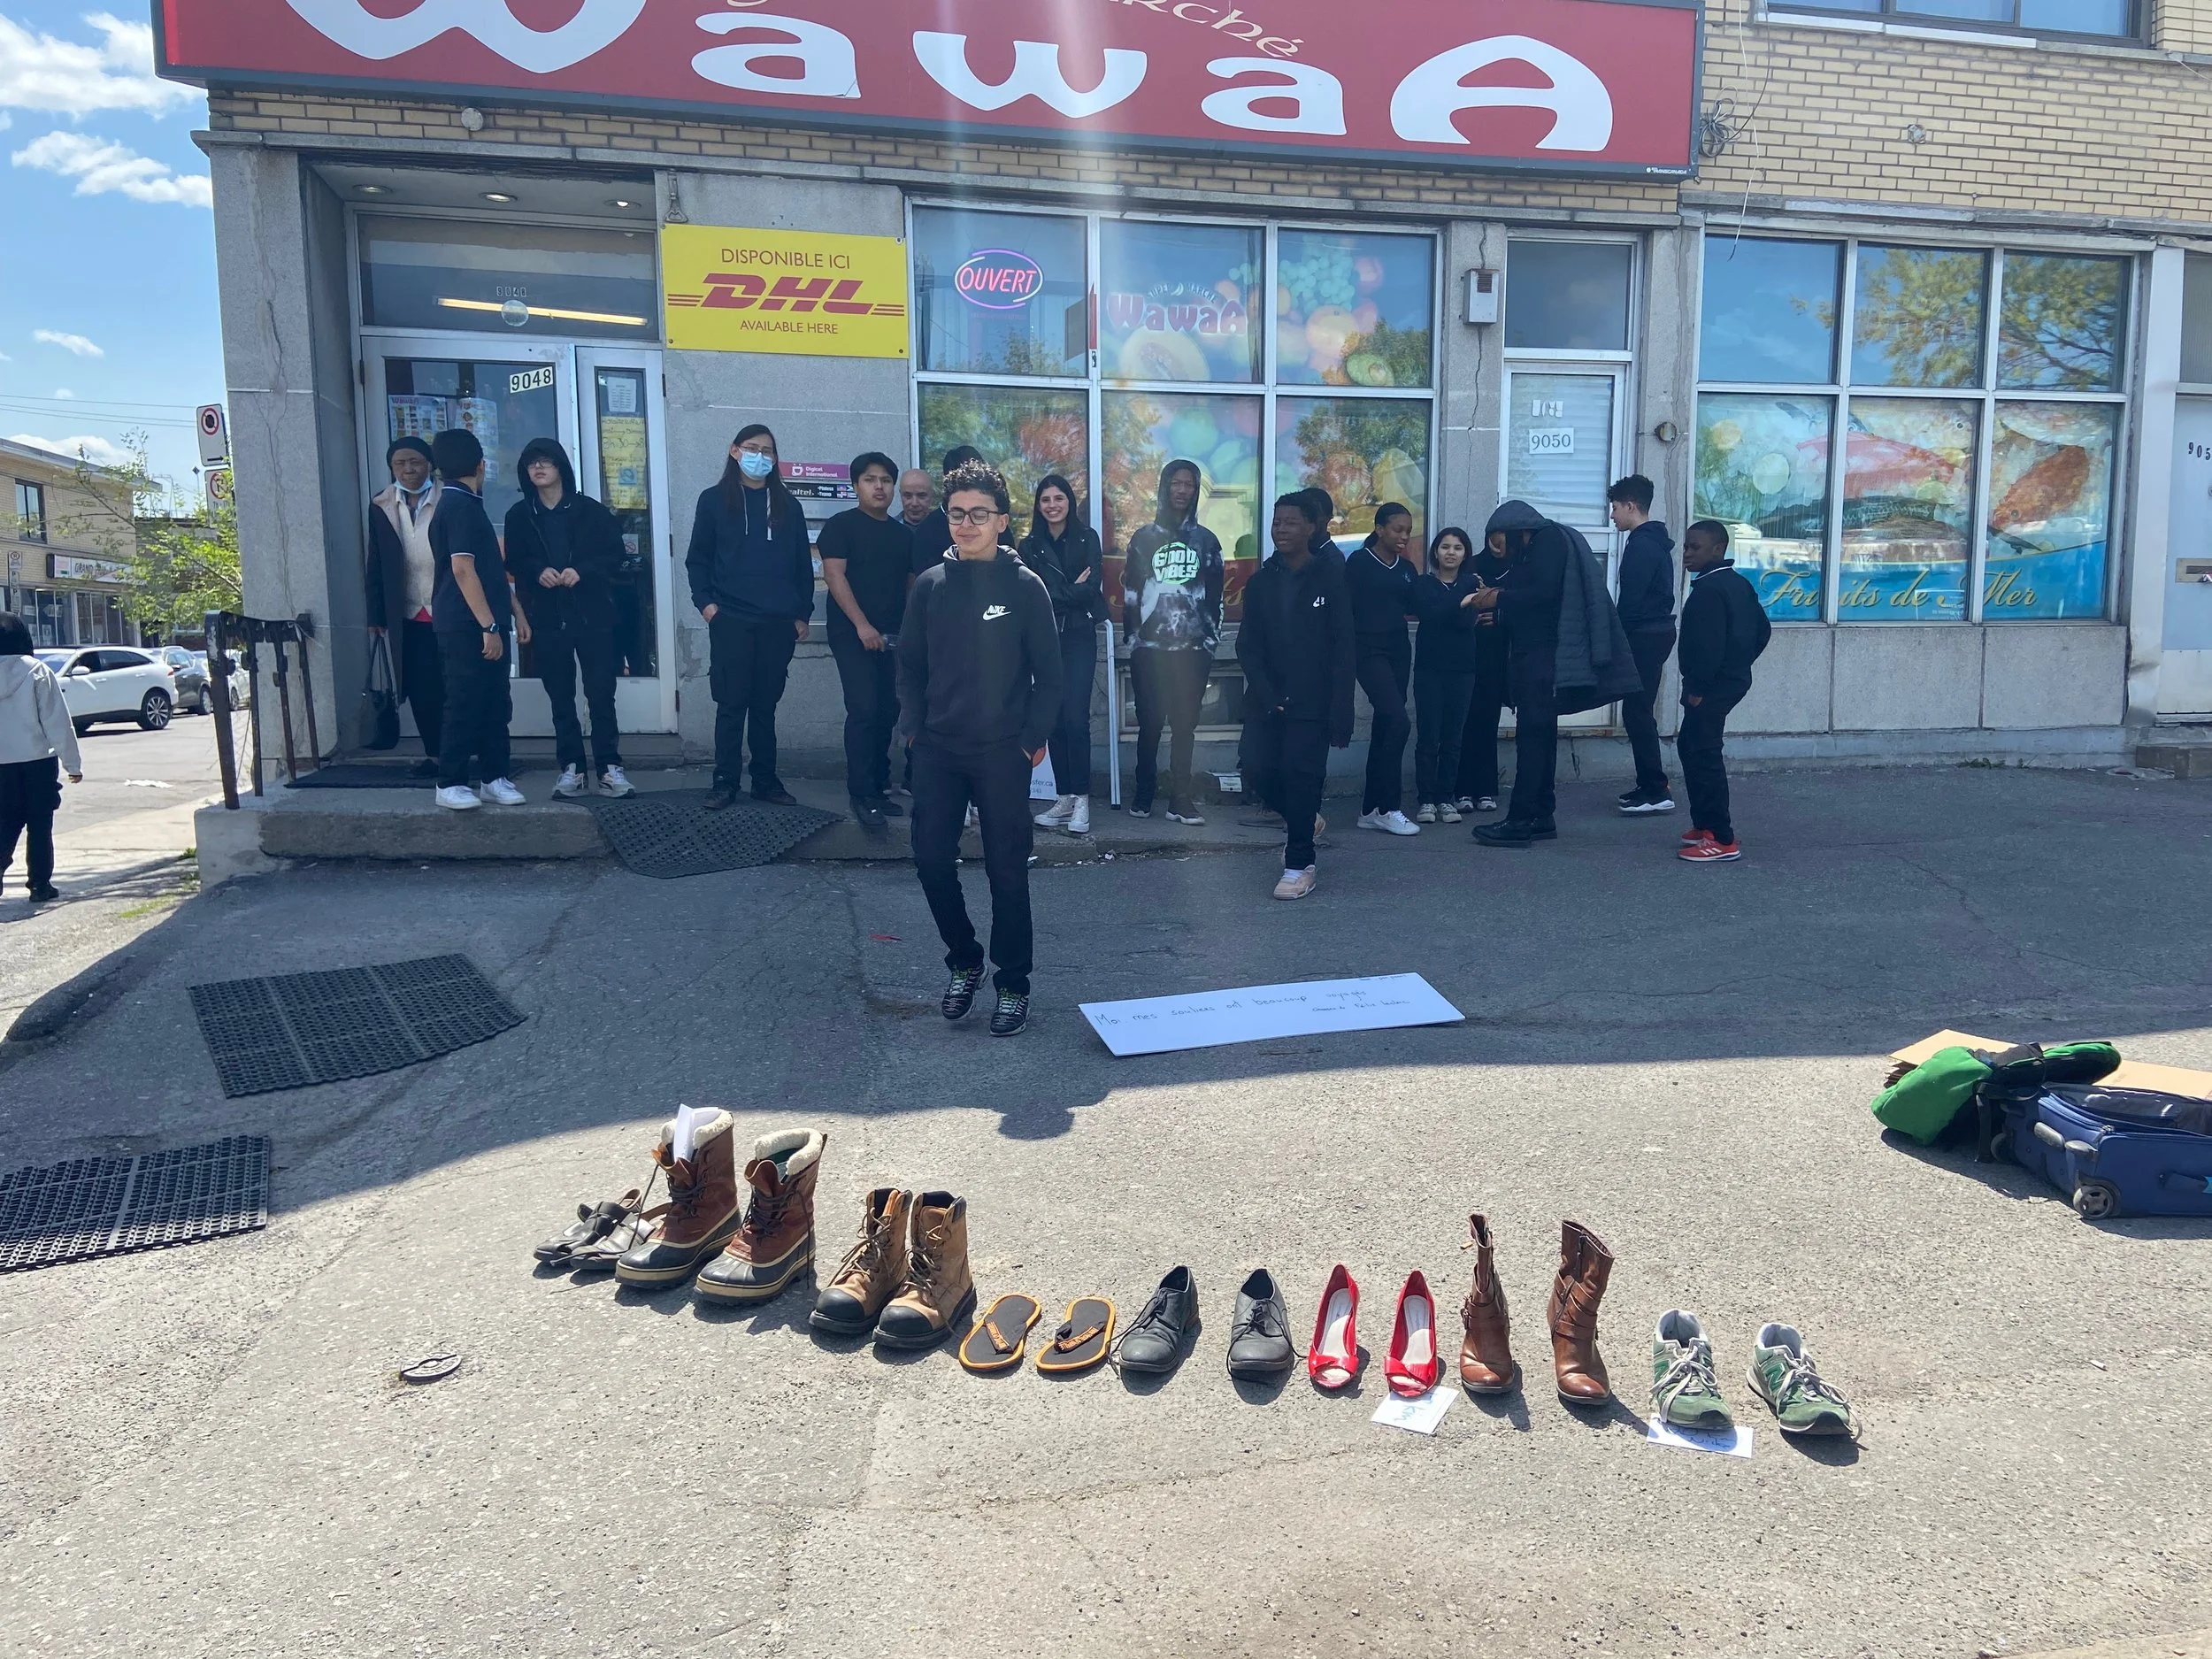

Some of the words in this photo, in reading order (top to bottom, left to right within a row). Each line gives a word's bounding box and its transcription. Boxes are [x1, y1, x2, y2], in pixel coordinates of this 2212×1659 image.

[721, 249, 824, 268] DISPONIBLE
[829, 255, 850, 269] ICI
[959, 267, 1037, 293] OUVERT
[496, 286, 526, 297] 9048
[701, 273, 874, 315] DHL
[740, 319, 804, 334] AVAILABLE
[807, 323, 839, 334] HERE
[511, 369, 552, 391] 9048
[1532, 434, 1571, 450] 9050
[1155, 549, 1197, 567] GOOD
[1155, 565, 1198, 583] VIBES
[1890, 568, 1929, 607] de
[1937, 567, 2039, 608] Mer
[1171, 1006, 1216, 1016] souliers
[1252, 995, 1307, 1006] beaucoup
